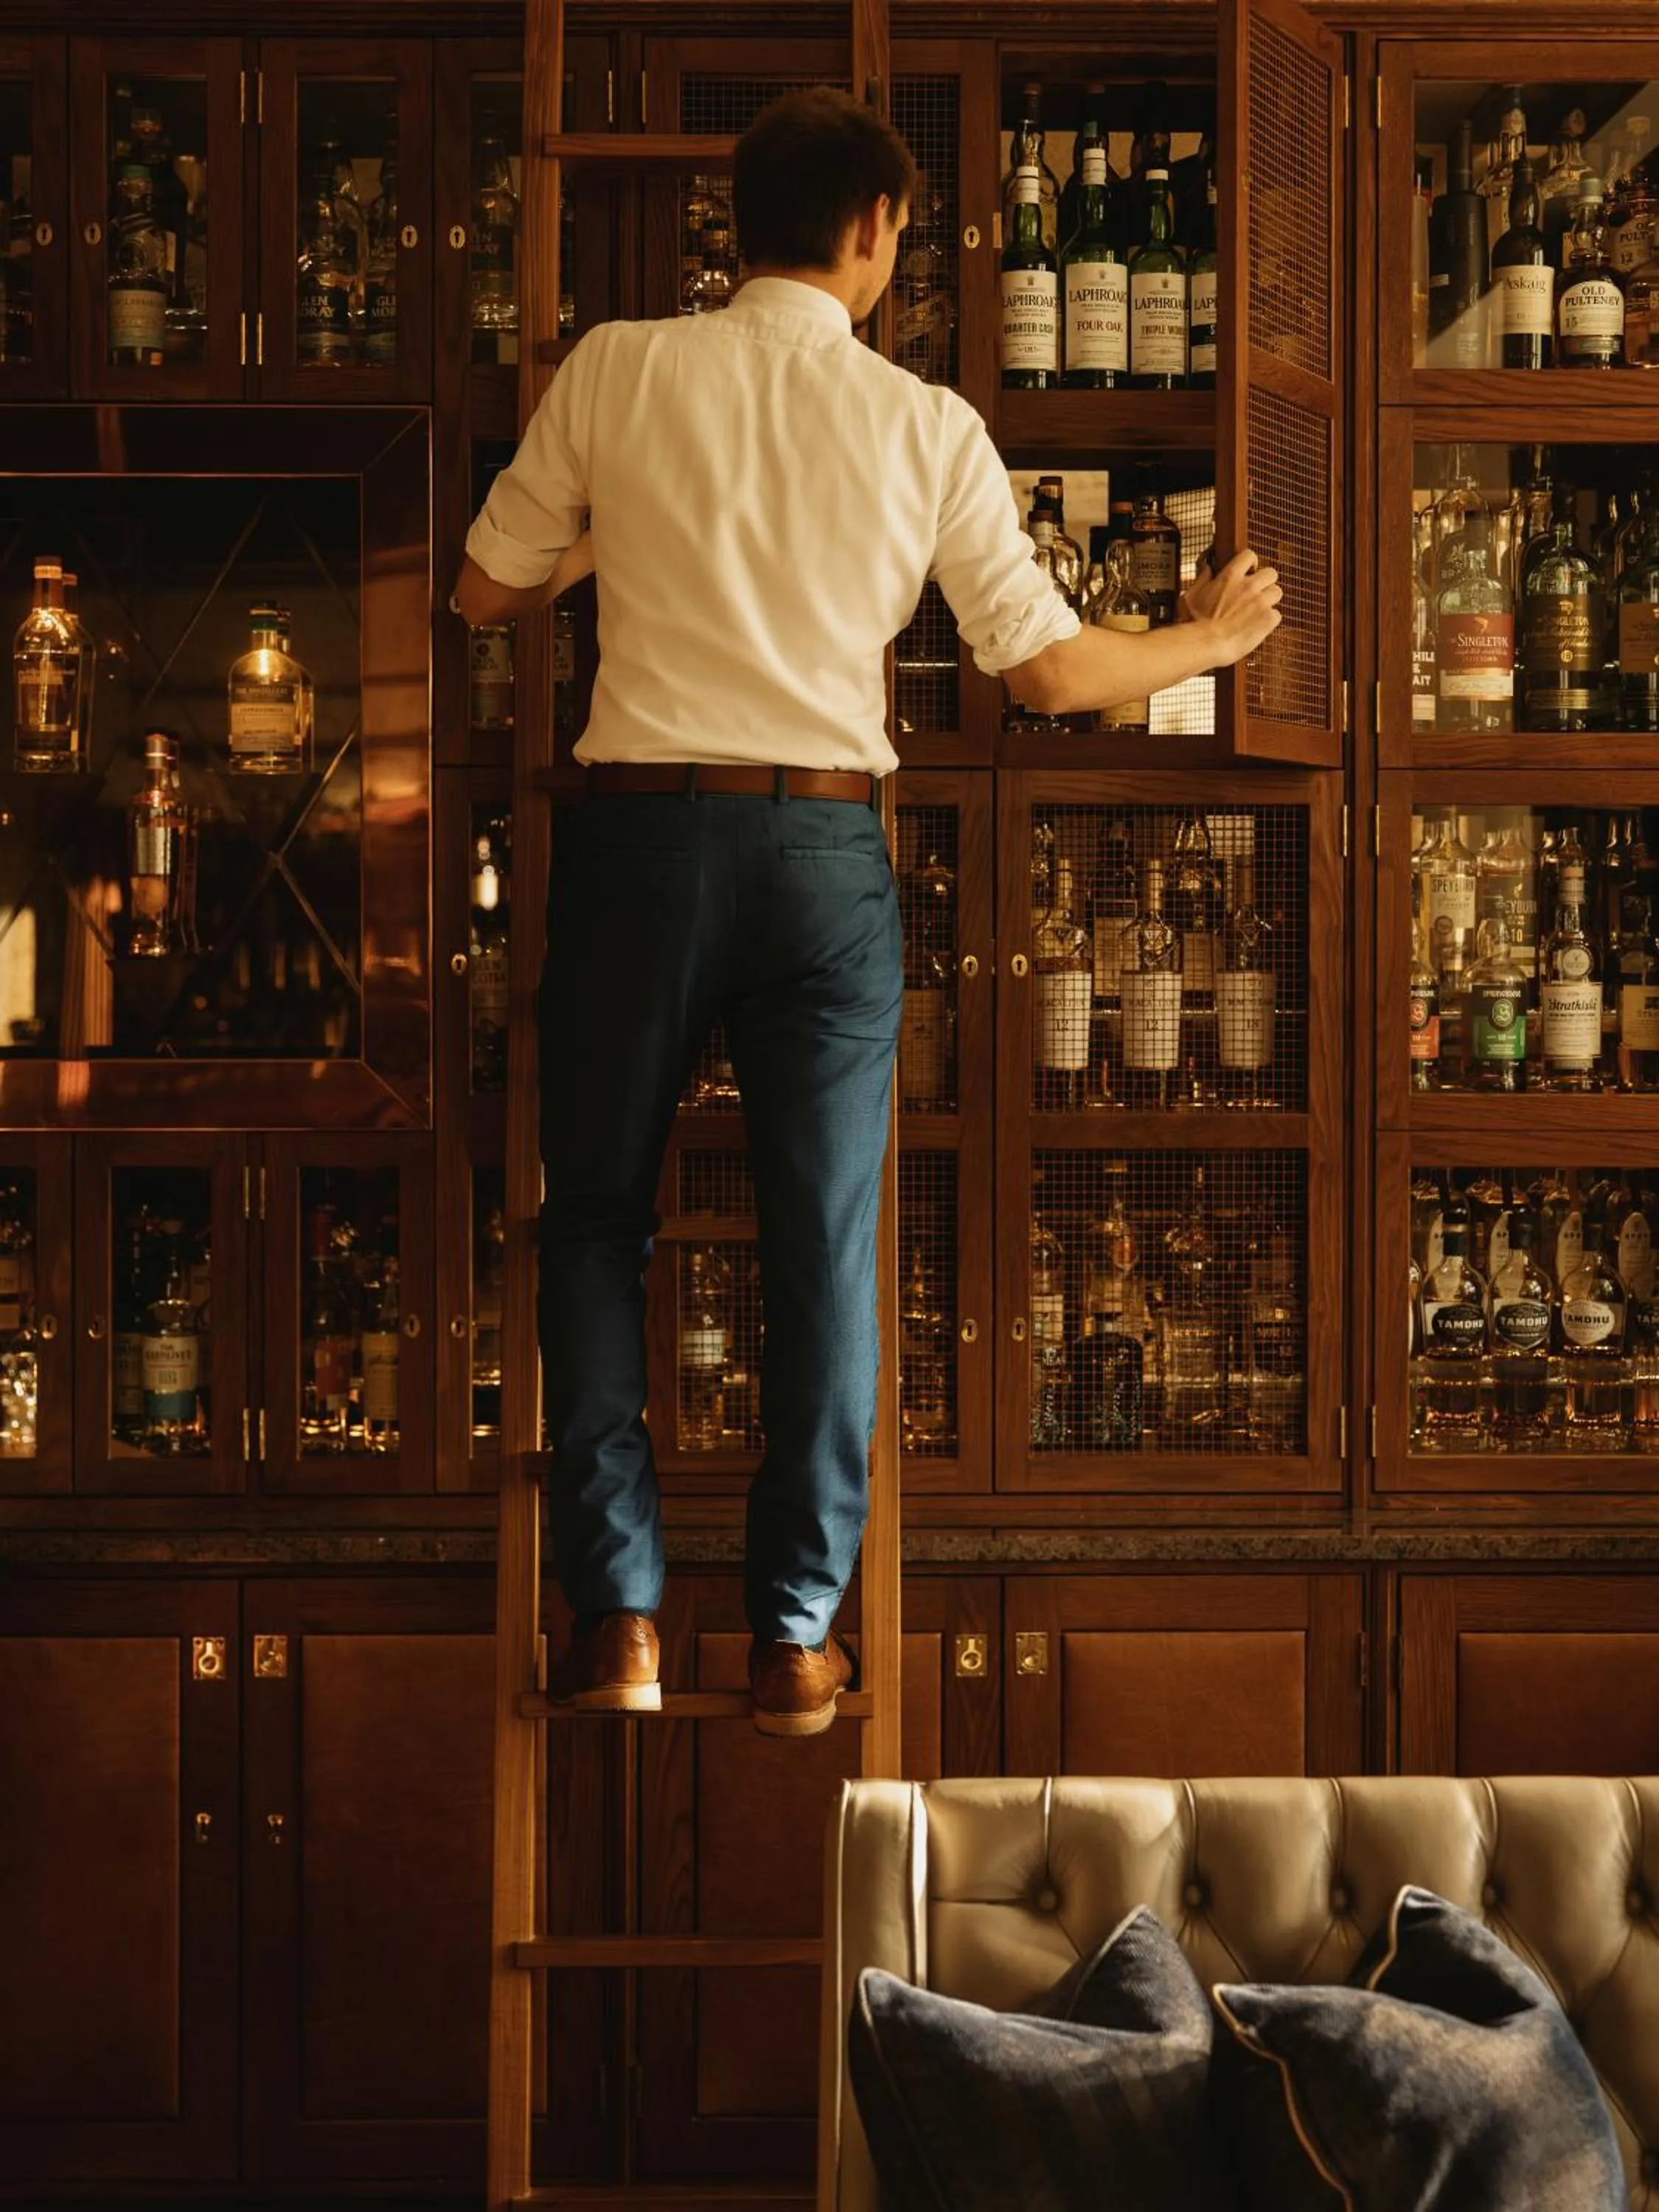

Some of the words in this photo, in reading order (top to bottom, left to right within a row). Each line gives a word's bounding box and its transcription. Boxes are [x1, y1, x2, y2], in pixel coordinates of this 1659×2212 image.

[1582, 285, 1605, 296] OLD
[1565, 296, 1620, 307] PULTENEY
[1077, 321, 1104, 332] FOUR
[1565, 316, 1577, 330] 15
[1458, 633, 1509, 647] SINGLETON
[1512, 928, 1523, 943] 10
[1437, 1318, 1484, 1329] TAMDHU
[1500, 1315, 1548, 1327] TAMDHU
[1565, 1314, 1610, 1324] TAMDHU
